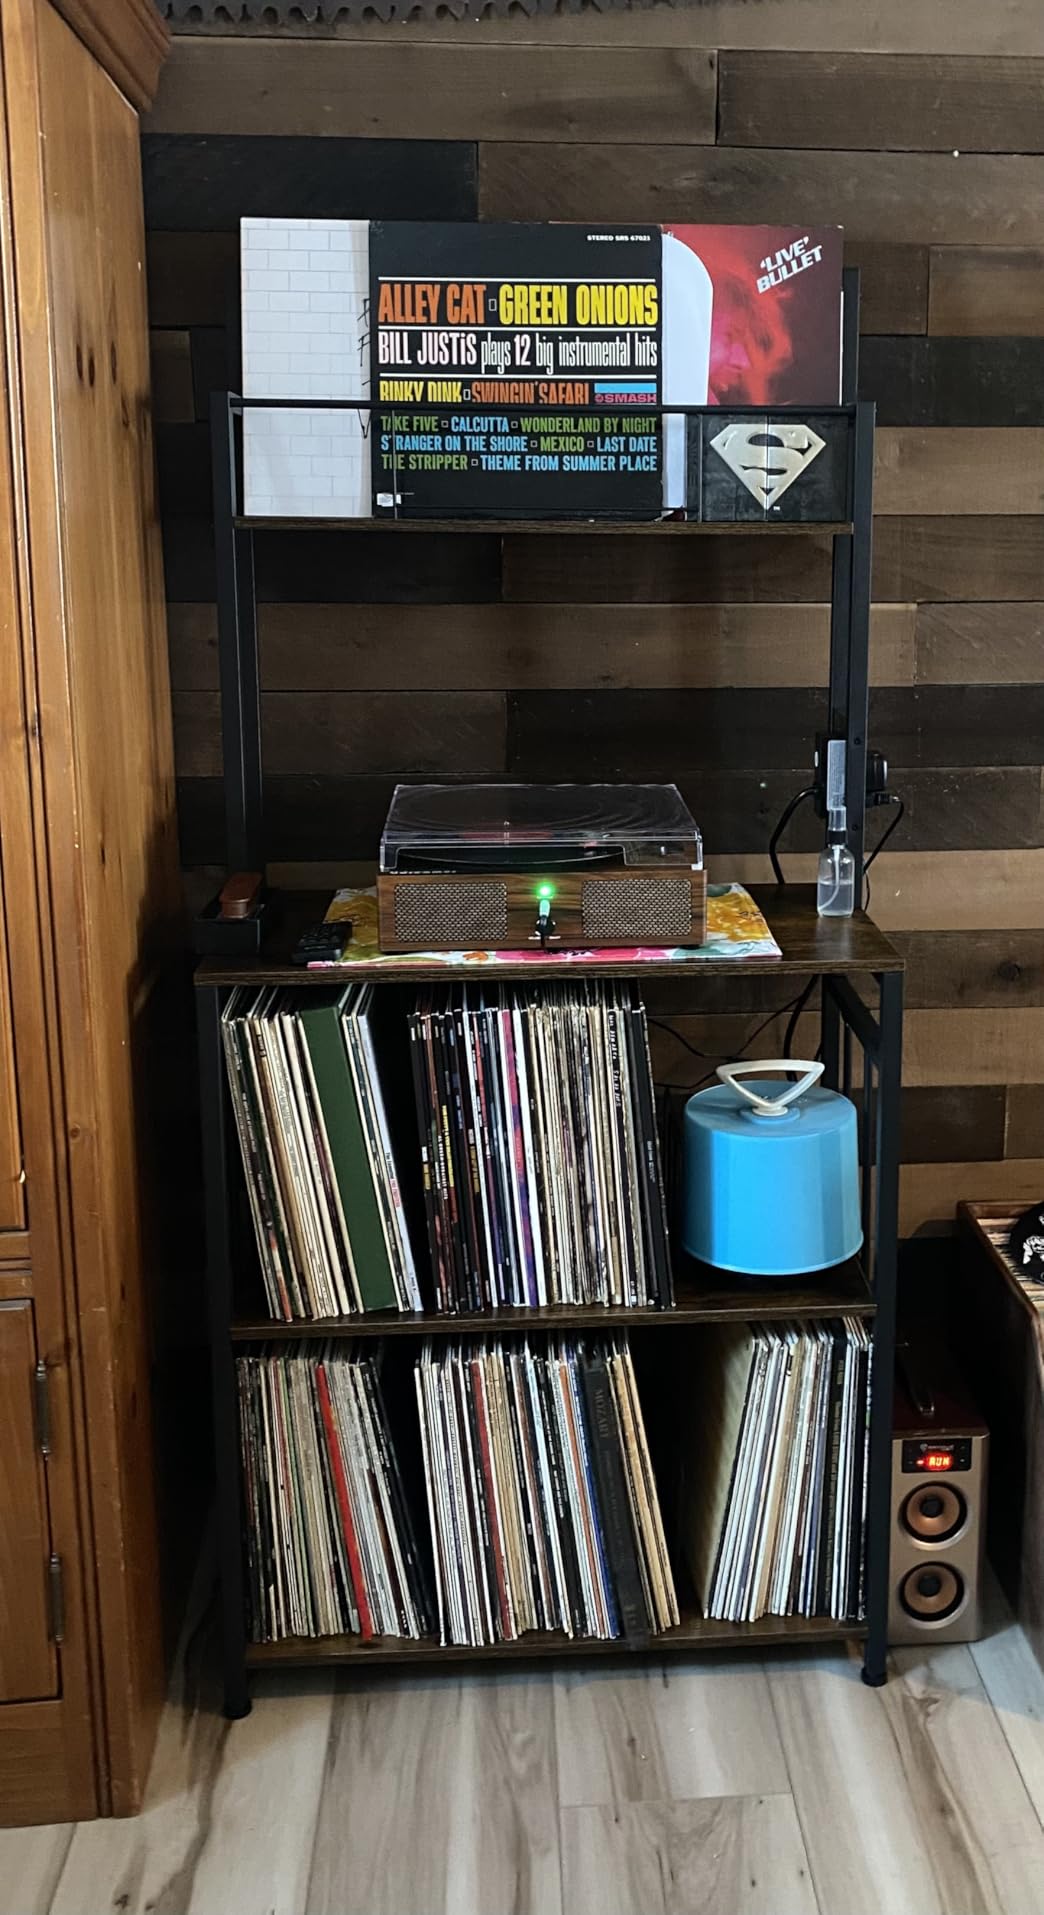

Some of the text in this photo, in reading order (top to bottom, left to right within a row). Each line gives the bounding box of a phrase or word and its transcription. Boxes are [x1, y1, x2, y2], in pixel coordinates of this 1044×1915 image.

[756, 245, 823, 295] BULLET
[378, 284, 658, 325] ALLEY CAT GREEN ONIONS
[378, 331, 412, 365] BILL
[480, 333, 511, 374] plays
[514, 334, 531, 366] 12
[535, 334, 554, 375] big
[559, 333, 631, 368] instrumental
[634, 333, 658, 368] hits
[379, 380, 424, 402] RINKY
[427, 381, 462, 402] DINK
[539, 382, 589, 405] SAFARI
[604, 394, 657, 403] SMASH
[413, 416, 439, 432] FIVE
[450, 417, 510, 432] CALCUTTA
[521, 417, 600, 433] WONDERLAND
[603, 417, 619, 433] BY
[622, 417, 657, 433] NIGHT
[381, 434, 658, 452] SRANGER ON THE SHORE MEXICO LAST DATE
[408, 454, 468, 470] STRIPPER
[480, 455, 521, 471] THEME
[525, 455, 559, 471] FROM
[562, 455, 616, 471] SUMMER
[619, 455, 658, 471] PLACE
